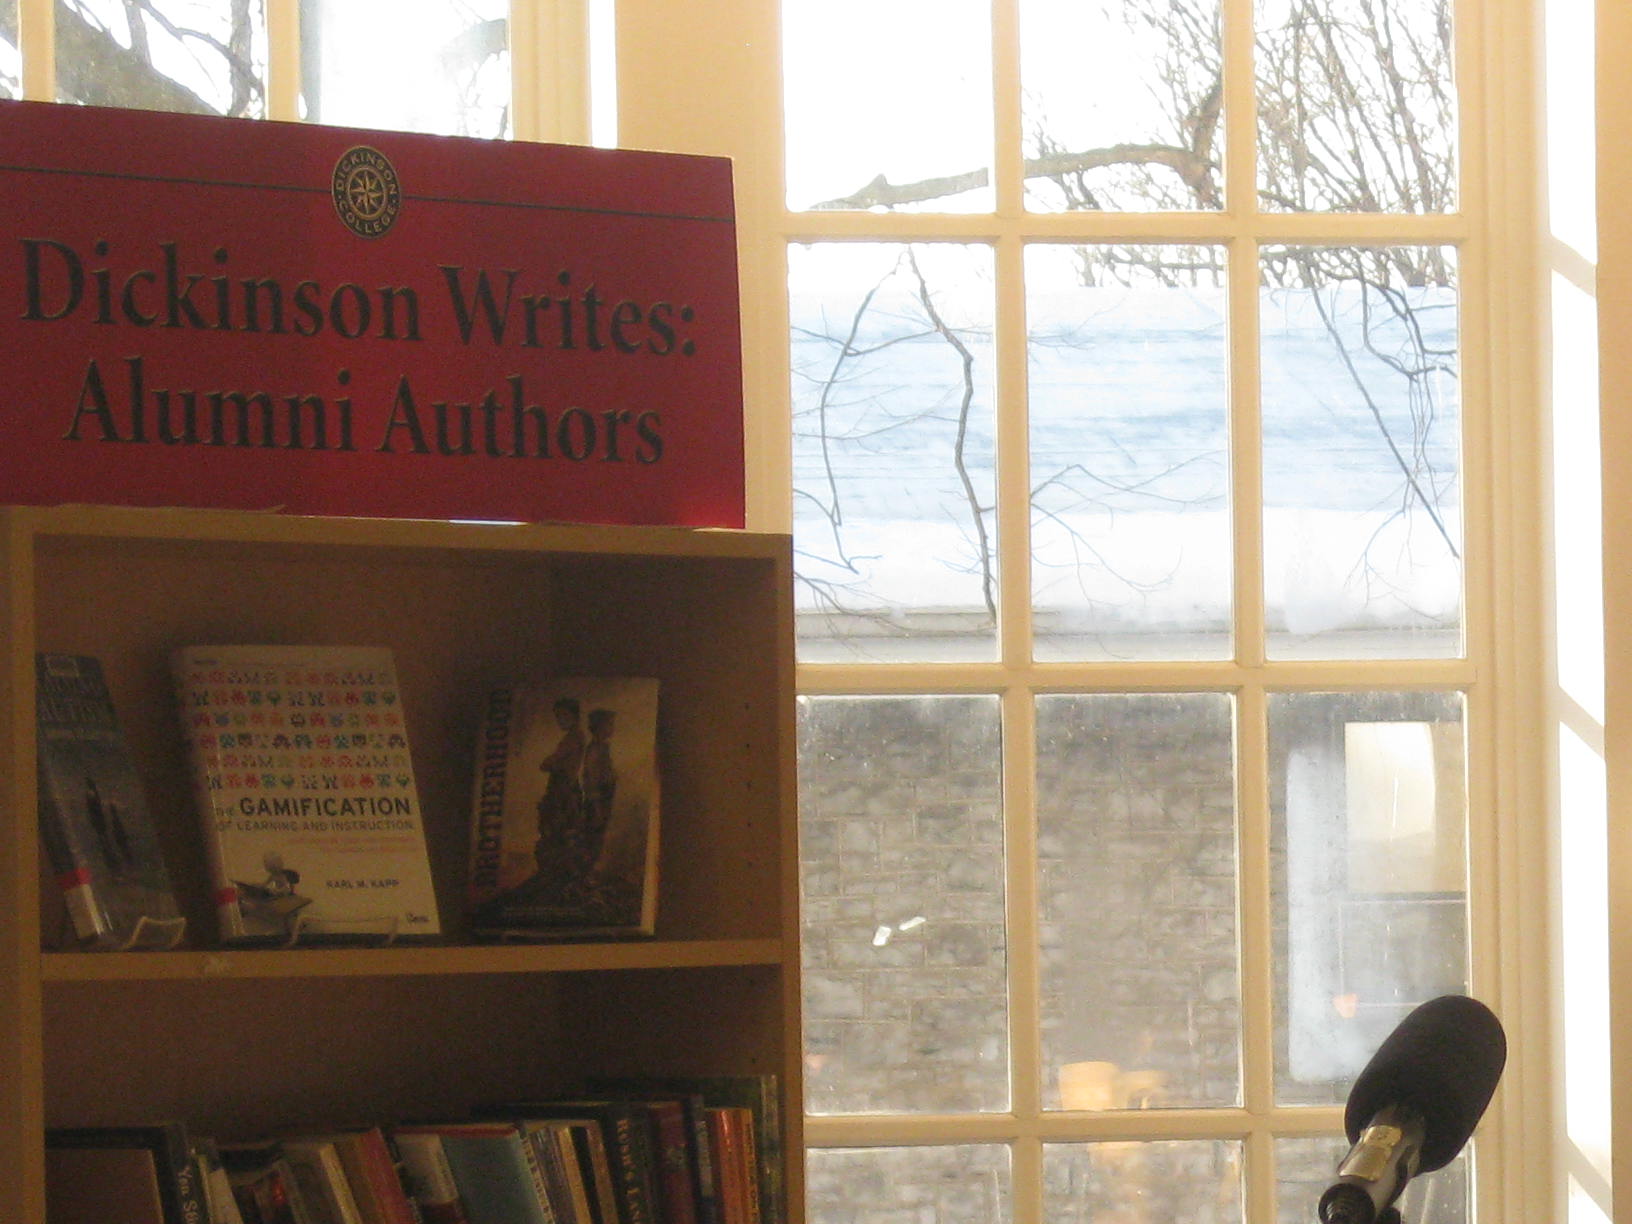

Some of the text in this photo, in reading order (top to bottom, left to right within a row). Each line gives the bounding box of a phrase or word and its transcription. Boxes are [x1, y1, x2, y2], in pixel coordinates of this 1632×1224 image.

[336, 152, 397, 194] DICKINSON
[338, 200, 397, 233] COLLEGE
[18, 237, 697, 356] Dickinson Writes:
[62, 356, 664, 464] Alumni Authors
[240, 797, 411, 816] GAMIFICATION
[237, 820, 297, 831] LEARNING
[302, 820, 327, 831] AND
[331, 820, 414, 831] INSTRUCTION
